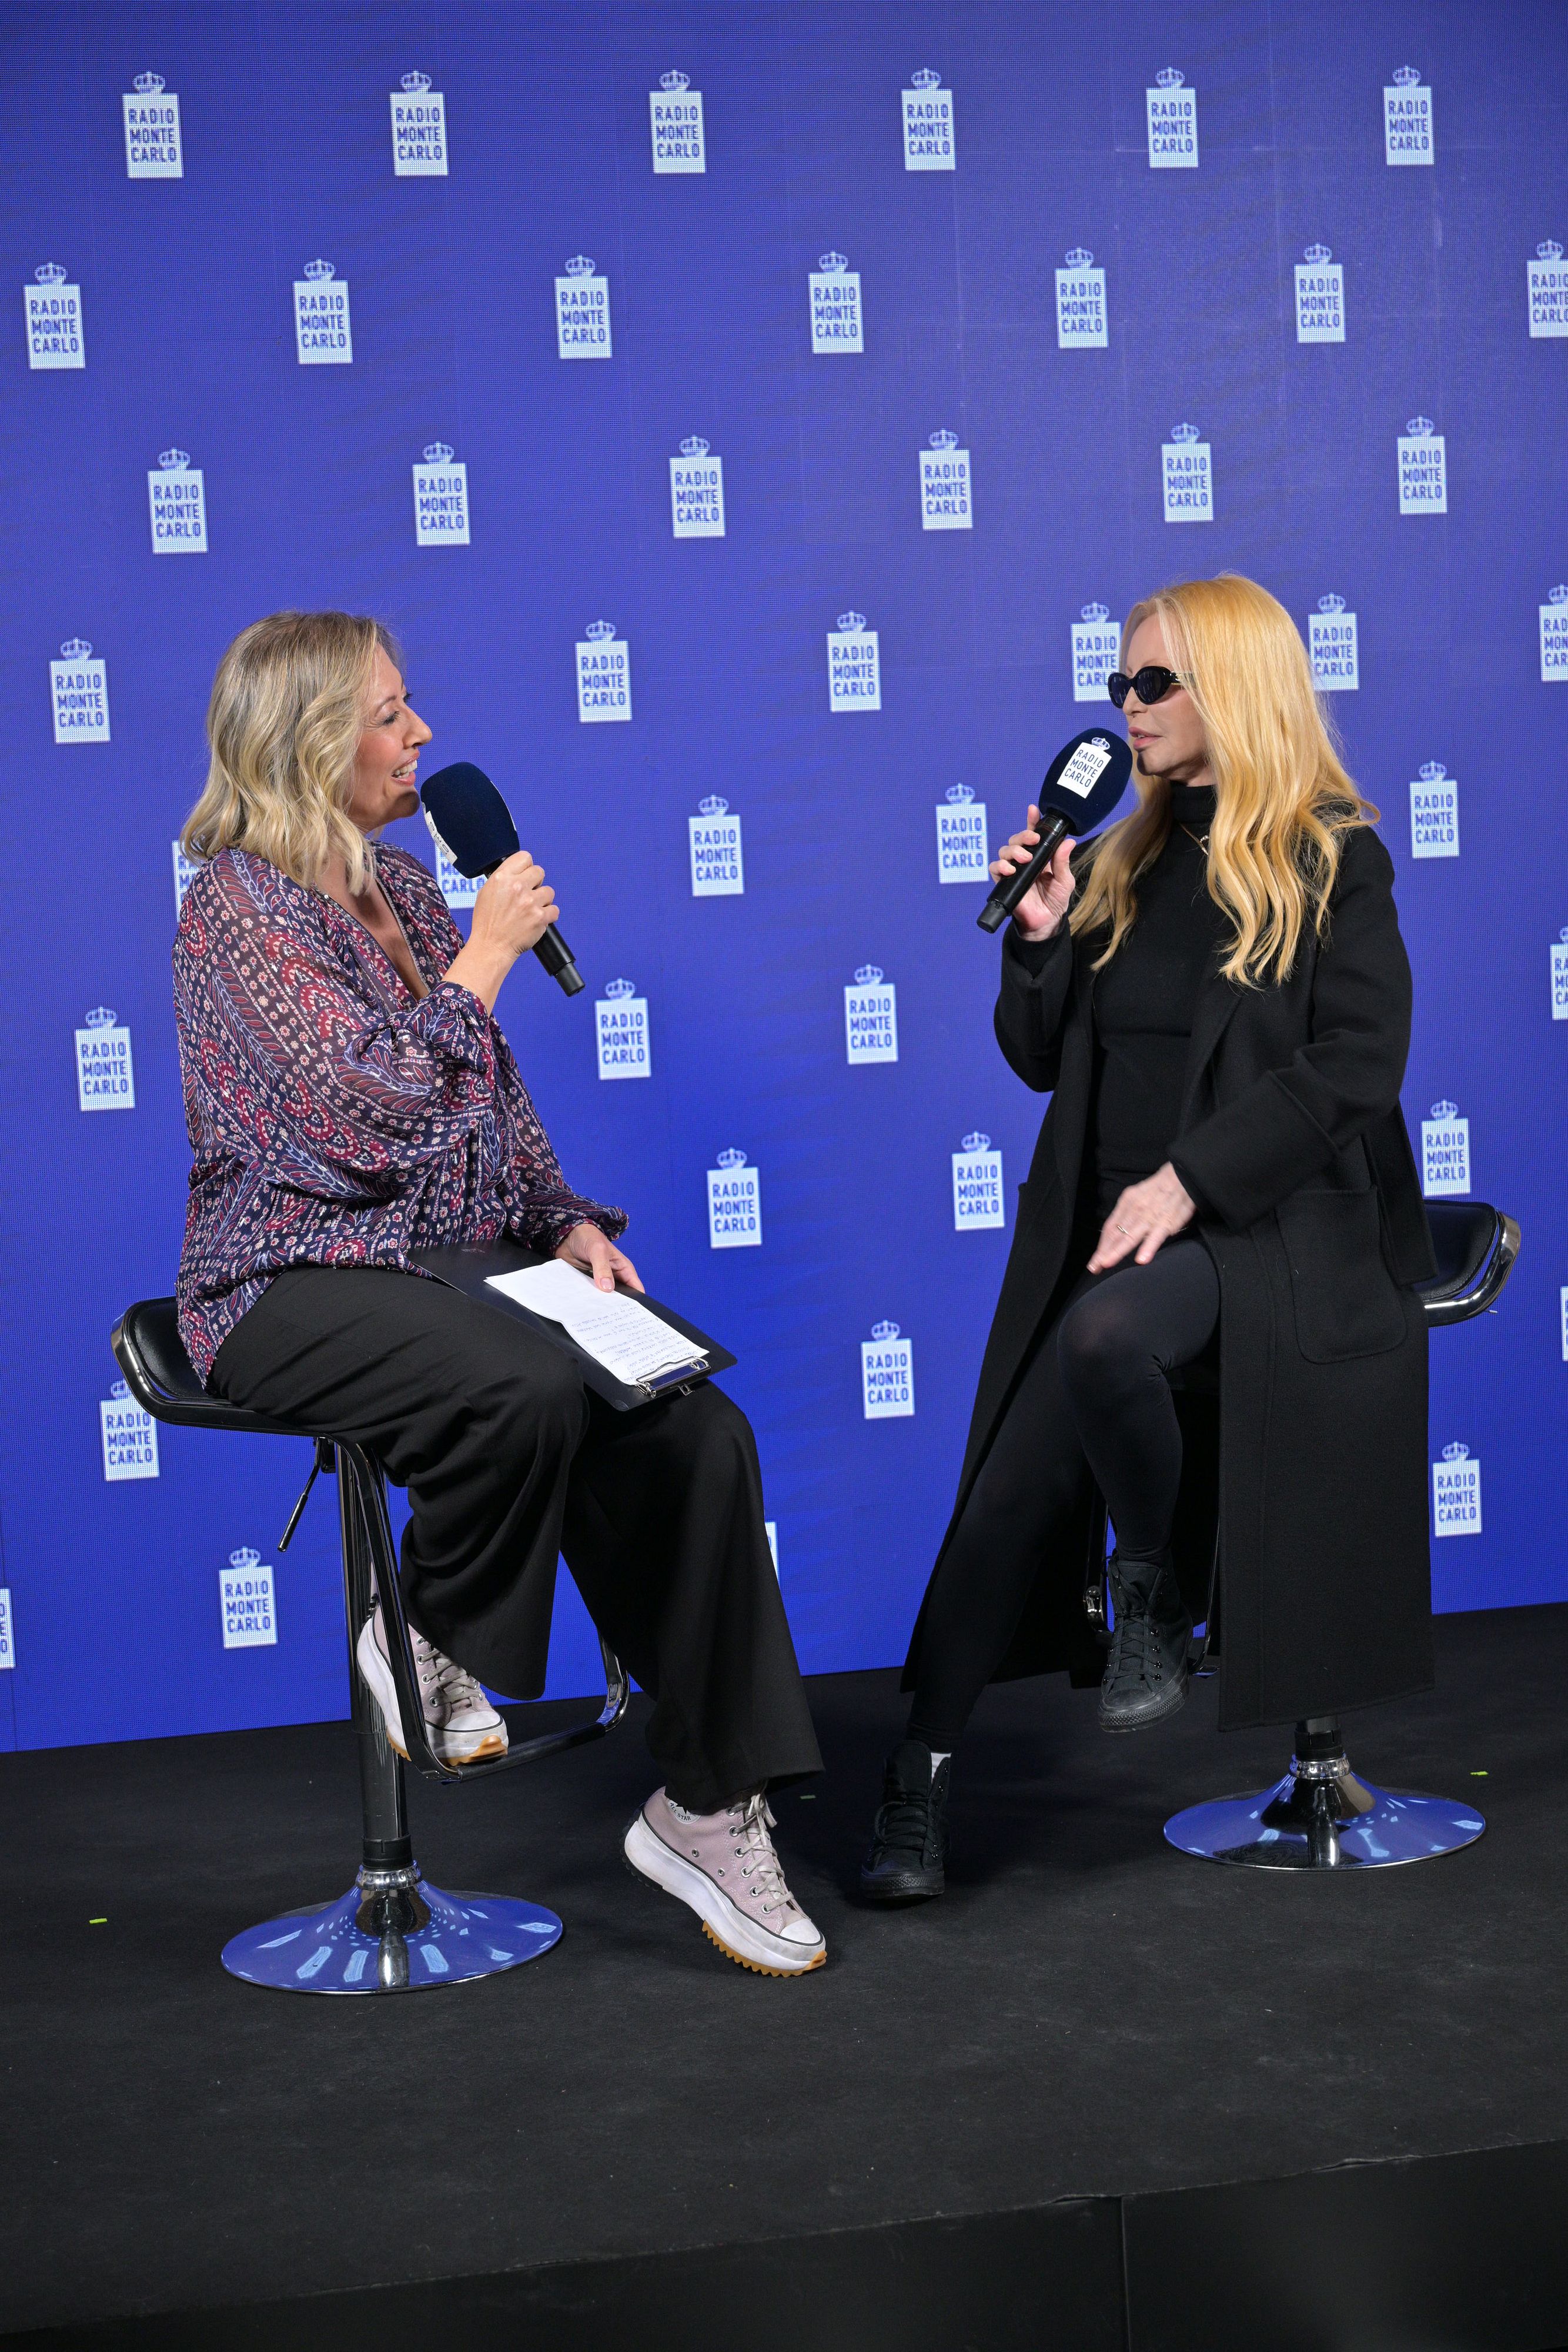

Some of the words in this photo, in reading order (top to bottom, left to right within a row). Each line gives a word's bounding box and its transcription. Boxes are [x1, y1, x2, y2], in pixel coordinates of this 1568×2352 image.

[396, 107, 440, 123] RADIO
[655, 106, 698, 121] RADIO
[907, 103, 948, 119] RADIO
[1151, 102, 1192, 117] RADIO
[1388, 100, 1427, 115] RADIO
[128, 108, 174, 124] RADIO
[656, 125, 698, 140] MONTE
[908, 122, 948, 138] MONTE
[1152, 121, 1191, 135] MONTE
[1389, 118, 1427, 133] MONTE
[130, 128, 174, 143] MONTE
[397, 126, 440, 142] MONTE
[657, 143, 700, 158] CARLO
[908, 141, 950, 155] CARLO
[1153, 138, 1193, 153] CARLO
[1390, 136, 1429, 150] CARLO
[131, 147, 176, 162] CARLO
[398, 145, 442, 161] CARLO
[1060, 282, 1101, 297] RADIO
[1299, 278, 1339, 292] RADIO
[560, 291, 604, 306] RADIO
[814, 286, 855, 302] RADIO
[30, 299, 76, 315] RADIO
[299, 295, 344, 311] RADIO
[1061, 300, 1101, 316] MONTE
[1300, 296, 1339, 310] MONTE
[561, 310, 603, 325] MONTE
[815, 305, 856, 320] MONTE
[31, 319, 76, 335] MONTE
[300, 315, 344, 330] MONTE
[1062, 318, 1102, 333] CARLO
[1300, 313, 1340, 329] CARLO
[562, 328, 606, 343] CARLO
[815, 323, 858, 339] CARLO
[33, 338, 79, 353] CARLO
[301, 333, 346, 349] CARLO
[1166, 457, 1207, 472] RADIO
[1402, 450, 1441, 465] RADIO
[675, 470, 717, 486] RADIO
[924, 463, 965, 479] RADIO
[1403, 467, 1440, 483] MONTE
[418, 477, 462, 493] RADIO
[925, 482, 965, 497] MONTE
[1167, 475, 1207, 490] MONTE
[153, 485, 199, 500] RADIO
[676, 489, 717, 505] MONTE
[1168, 492, 1208, 507] CARLO
[1403, 485, 1442, 500] CARLO
[155, 503, 199, 520] MONTE
[419, 496, 463, 512] MONTE
[926, 500, 967, 515] CARLO
[420, 514, 464, 530] CARLO
[677, 507, 719, 523] CARLO
[156, 522, 201, 538] CARLO
[1544, 618, 1568, 632] RAD
[1313, 626, 1352, 642] RADIO
[1076, 636, 1116, 650] RADIO
[1544, 636, 1568, 650] MON
[832, 645, 874, 661] RADIO
[1314, 644, 1352, 660] MONTE
[1544, 653, 1568, 667] CAR
[581, 654, 624, 671] RADIO
[1077, 654, 1117, 669] MONTE
[1316, 661, 1353, 676] CARLO
[833, 663, 874, 679] MONTE
[56, 674, 101, 690] RADIO
[582, 673, 624, 689] MONTE
[1078, 672, 1109, 687] CARL
[834, 681, 875, 697] CARLO
[57, 693, 102, 709] MONTE
[583, 691, 626, 707] CARLO
[58, 711, 103, 728] CARLO
[1076, 750, 1104, 768] RADIO
[1070, 759, 1098, 778] MONTE
[1065, 768, 1092, 787] CARLO
[1415, 794, 1453, 809] RADIO
[942, 817, 982, 833] RADIO
[1415, 811, 1452, 827] MONTE
[694, 829, 736, 845] RADIO
[942, 836, 982, 851] MONTE
[1416, 828, 1454, 844] CARLO
[695, 847, 736, 863] MONTE
[943, 853, 983, 868] CARLO
[696, 865, 738, 881] CARLO
[850, 998, 891, 1014] RADIO
[600, 1013, 643, 1028] RADIO
[850, 1016, 890, 1031] MONTE
[601, 1031, 643, 1047] MONTE
[851, 1033, 892, 1050] CARLO
[81, 1042, 126, 1058] RADIO
[603, 1048, 645, 1065] CARLO
[82, 1060, 126, 1077] MONTE
[83, 1078, 128, 1095] CARLO
[1426, 1132, 1465, 1147] RADIO
[1427, 1150, 1464, 1164] MONTE
[957, 1165, 998, 1181] RADIO
[1427, 1167, 1465, 1182] CARLO
[713, 1181, 754, 1197] RADIO
[958, 1182, 997, 1198] MONTE
[713, 1200, 754, 1215] MONTE
[959, 1200, 999, 1216] CARLO
[714, 1217, 755, 1233] CARLO
[867, 1353, 907, 1369] RADIO
[867, 1371, 907, 1387] MONTE
[868, 1388, 908, 1404] CARLO
[106, 1413, 151, 1429] RADIO
[108, 1431, 151, 1447] MONTE
[108, 1448, 152, 1465] CARLO
[1437, 1474, 1475, 1488] RADIO
[1438, 1491, 1475, 1505] MONTE
[1439, 1506, 1476, 1522] CARLO
[225, 1580, 268, 1597] RADIO
[226, 1599, 269, 1615] MONTE
[227, 1616, 270, 1633] CARLO
[678, 1813, 691, 1821] STAR
